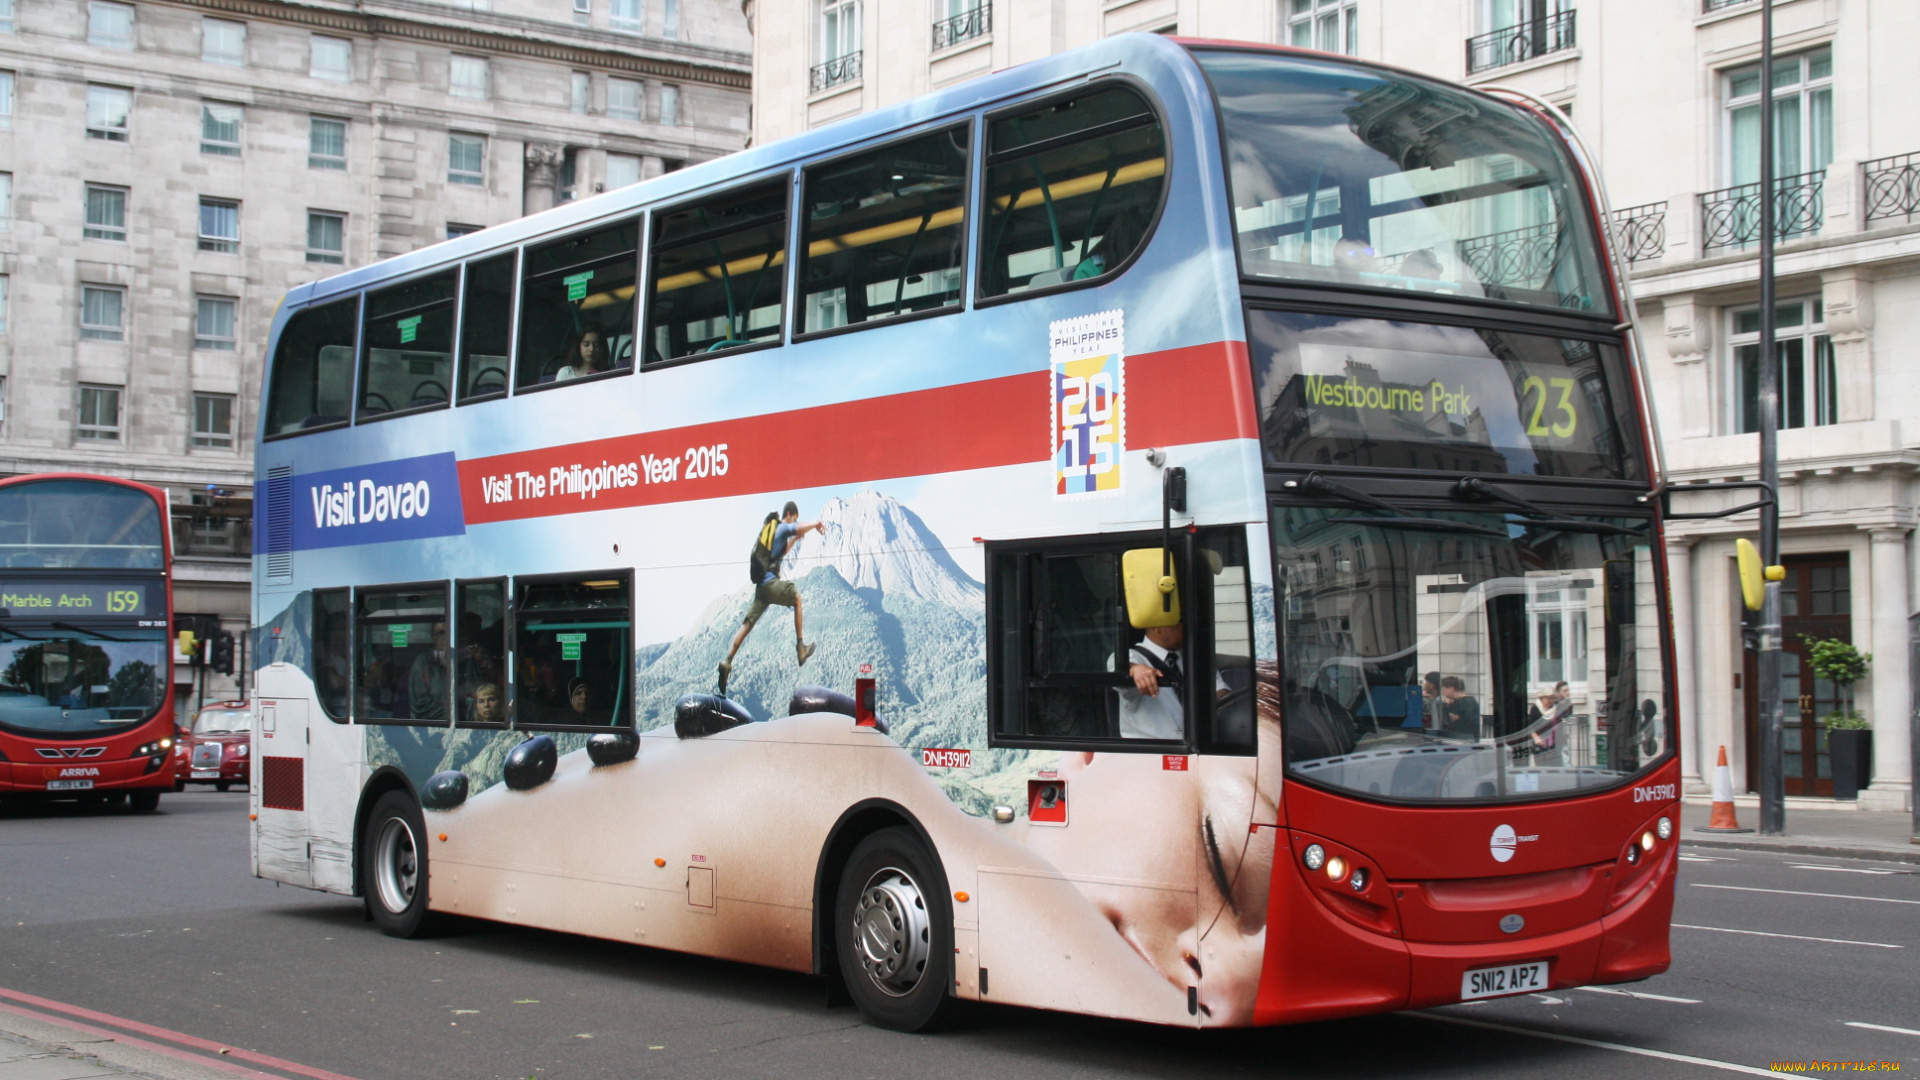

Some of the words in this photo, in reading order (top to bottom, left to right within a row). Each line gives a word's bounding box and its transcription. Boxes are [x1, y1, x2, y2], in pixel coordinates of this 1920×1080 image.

[1054, 328, 1118, 348] PHILIPPINES
[1058, 323, 1089, 335] VISIT
[1305, 372, 1424, 413] Westbourne
[1432, 382, 1471, 416] Park
[1524, 375, 1577, 439] 23
[481, 474, 513, 504] Visit
[515, 471, 546, 500] The
[550, 460, 638, 500] Philippines
[640, 453, 680, 484] Year
[684, 443, 729, 479] 2015
[311, 482, 355, 528] Visit
[359, 479, 430, 523] Davao
[2, 594, 52, 607] Marble
[58, 594, 92, 607] Arch
[107, 591, 139, 612] 159
[923, 750, 971, 768] DNH39112
[60, 767, 100, 777] ARRIVA
[1633, 783, 1676, 803] DNH39112
[1471, 970, 1505, 993] SN12
[1510, 966, 1539, 989] APZ
